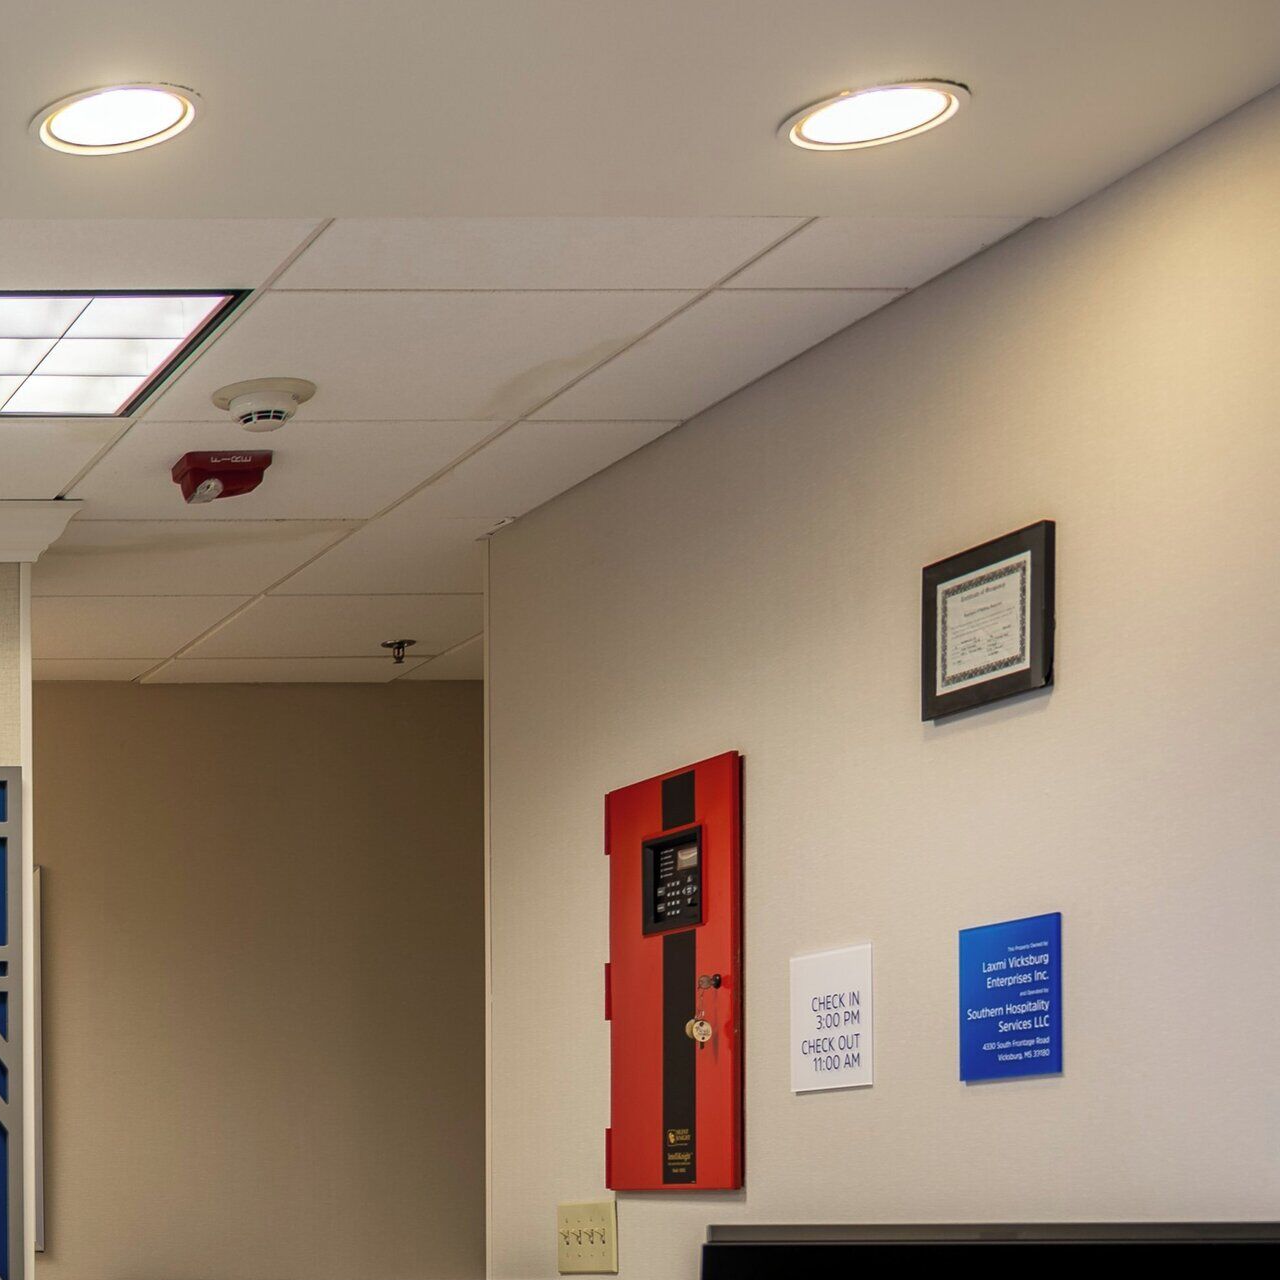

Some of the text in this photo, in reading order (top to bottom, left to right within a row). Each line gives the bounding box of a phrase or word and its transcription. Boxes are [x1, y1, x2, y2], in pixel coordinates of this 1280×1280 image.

[982, 952, 1049, 973] Laxmi Vicksburg
[987, 969, 1049, 988] Enterprises Inc.
[811, 991, 860, 1012] CHECK IN
[967, 1000, 1050, 1020] Southern Hospitality
[816, 1009, 860, 1030] 3:00 PM
[998, 1015, 1049, 1032] Services LLC
[801, 1033, 860, 1055] CHECK OUT
[997, 1041, 1011, 1049] South
[1012, 1039, 1034, 1047] Frontage
[1036, 1036, 1050, 1044] Road
[813, 1053, 860, 1072] 11:00 AM
[1024, 1050, 1032, 1058] MS
